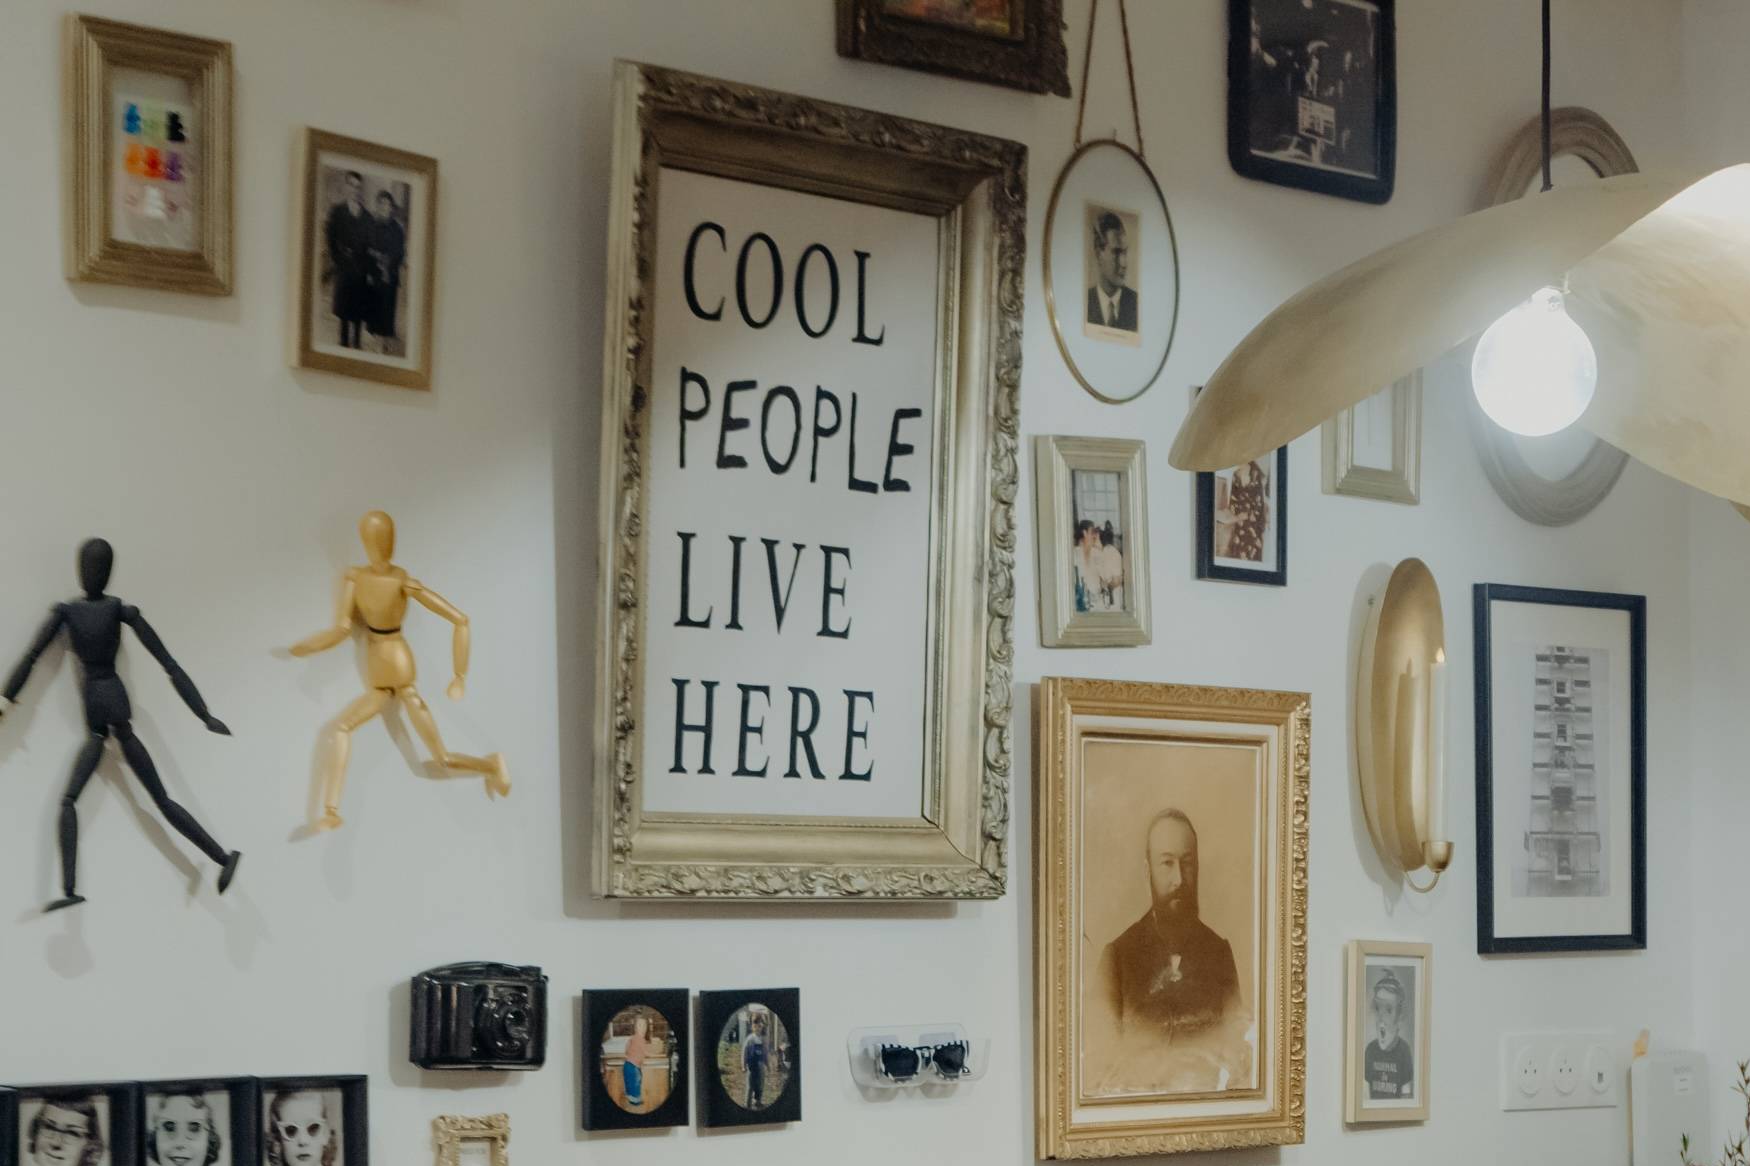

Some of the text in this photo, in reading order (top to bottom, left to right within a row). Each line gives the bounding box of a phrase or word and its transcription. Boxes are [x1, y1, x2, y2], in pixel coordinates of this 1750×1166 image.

[682, 221, 885, 346] COOL
[678, 366, 922, 494] PEOPLE
[673, 531, 852, 640] LIVE
[668, 678, 875, 782] HERE
